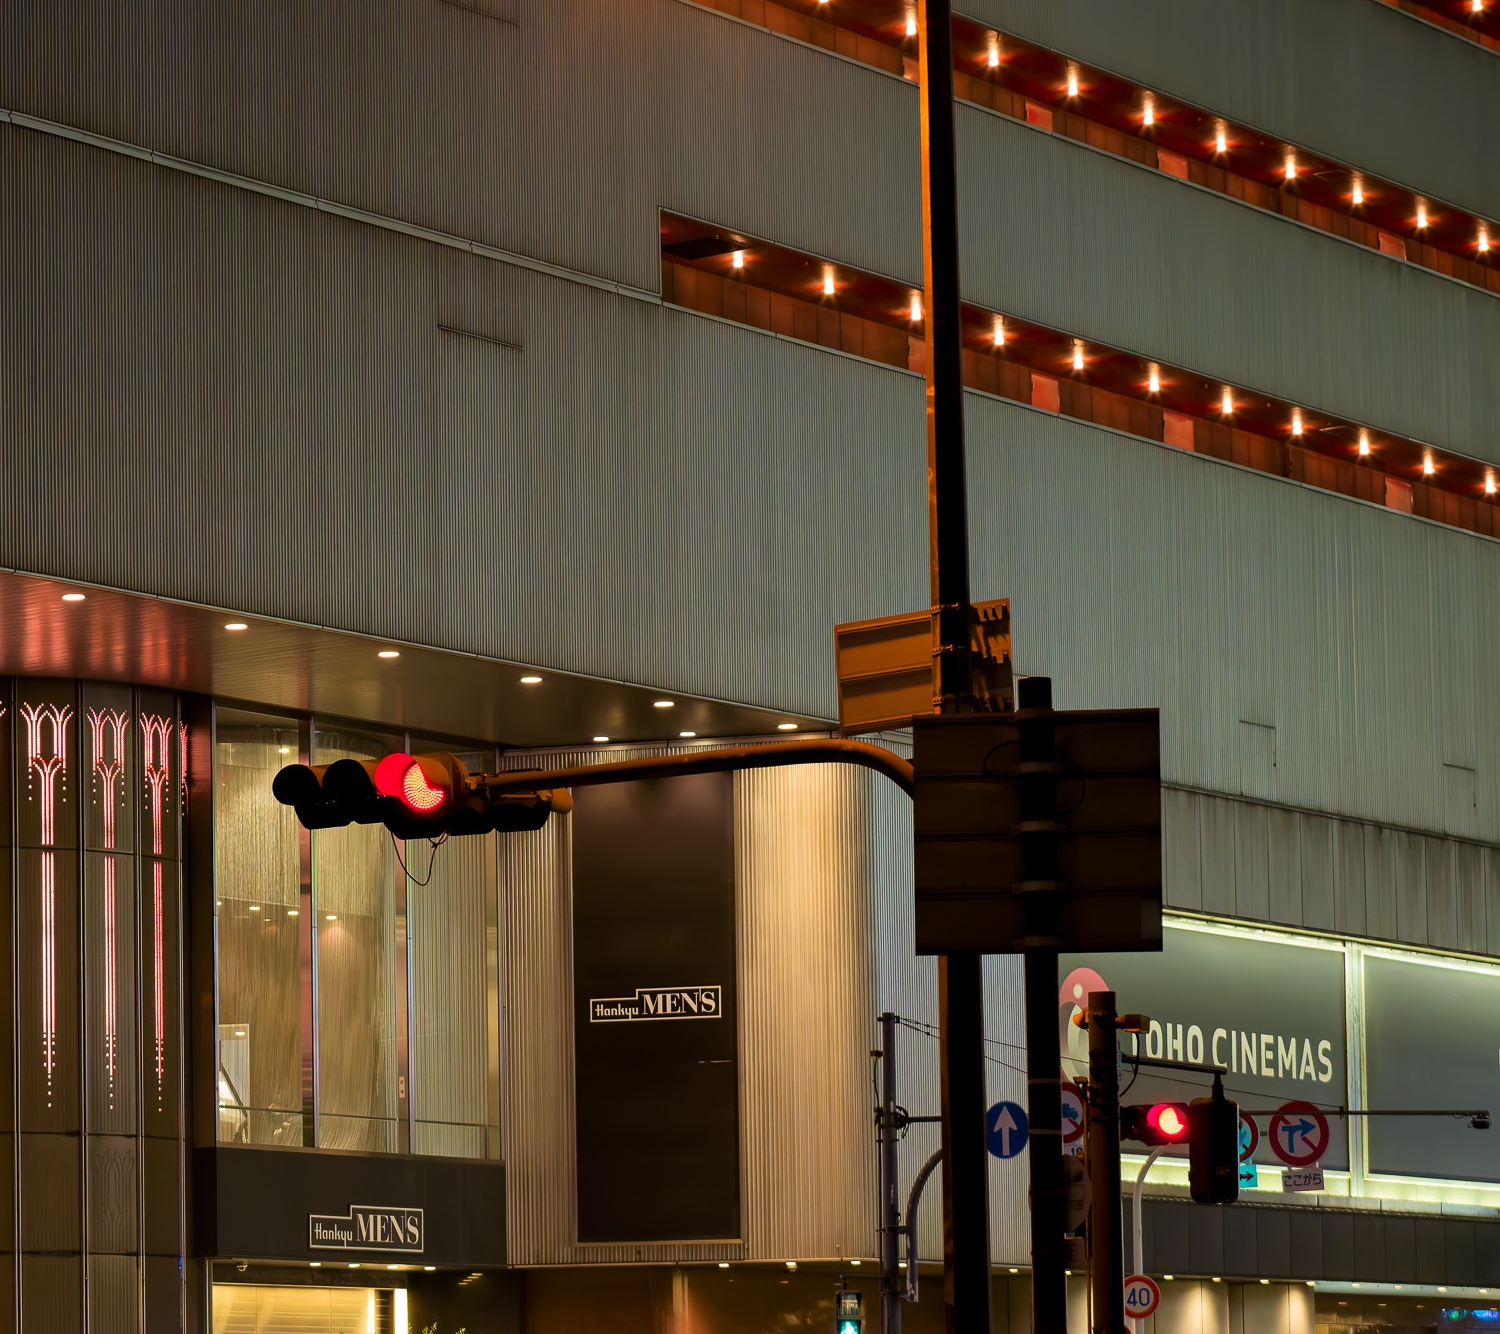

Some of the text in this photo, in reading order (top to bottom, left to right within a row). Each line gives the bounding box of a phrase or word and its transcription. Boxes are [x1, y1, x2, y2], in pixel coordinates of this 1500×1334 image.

[595, 988, 716, 1019] Hankyu MEN'S
[1212, 1028, 1333, 1083] CINEMAS
[1284, 1173, 1322, 1186] ここから
[314, 1209, 419, 1247] Hankyu MEN'S
[1126, 1287, 1151, 1307] 40
